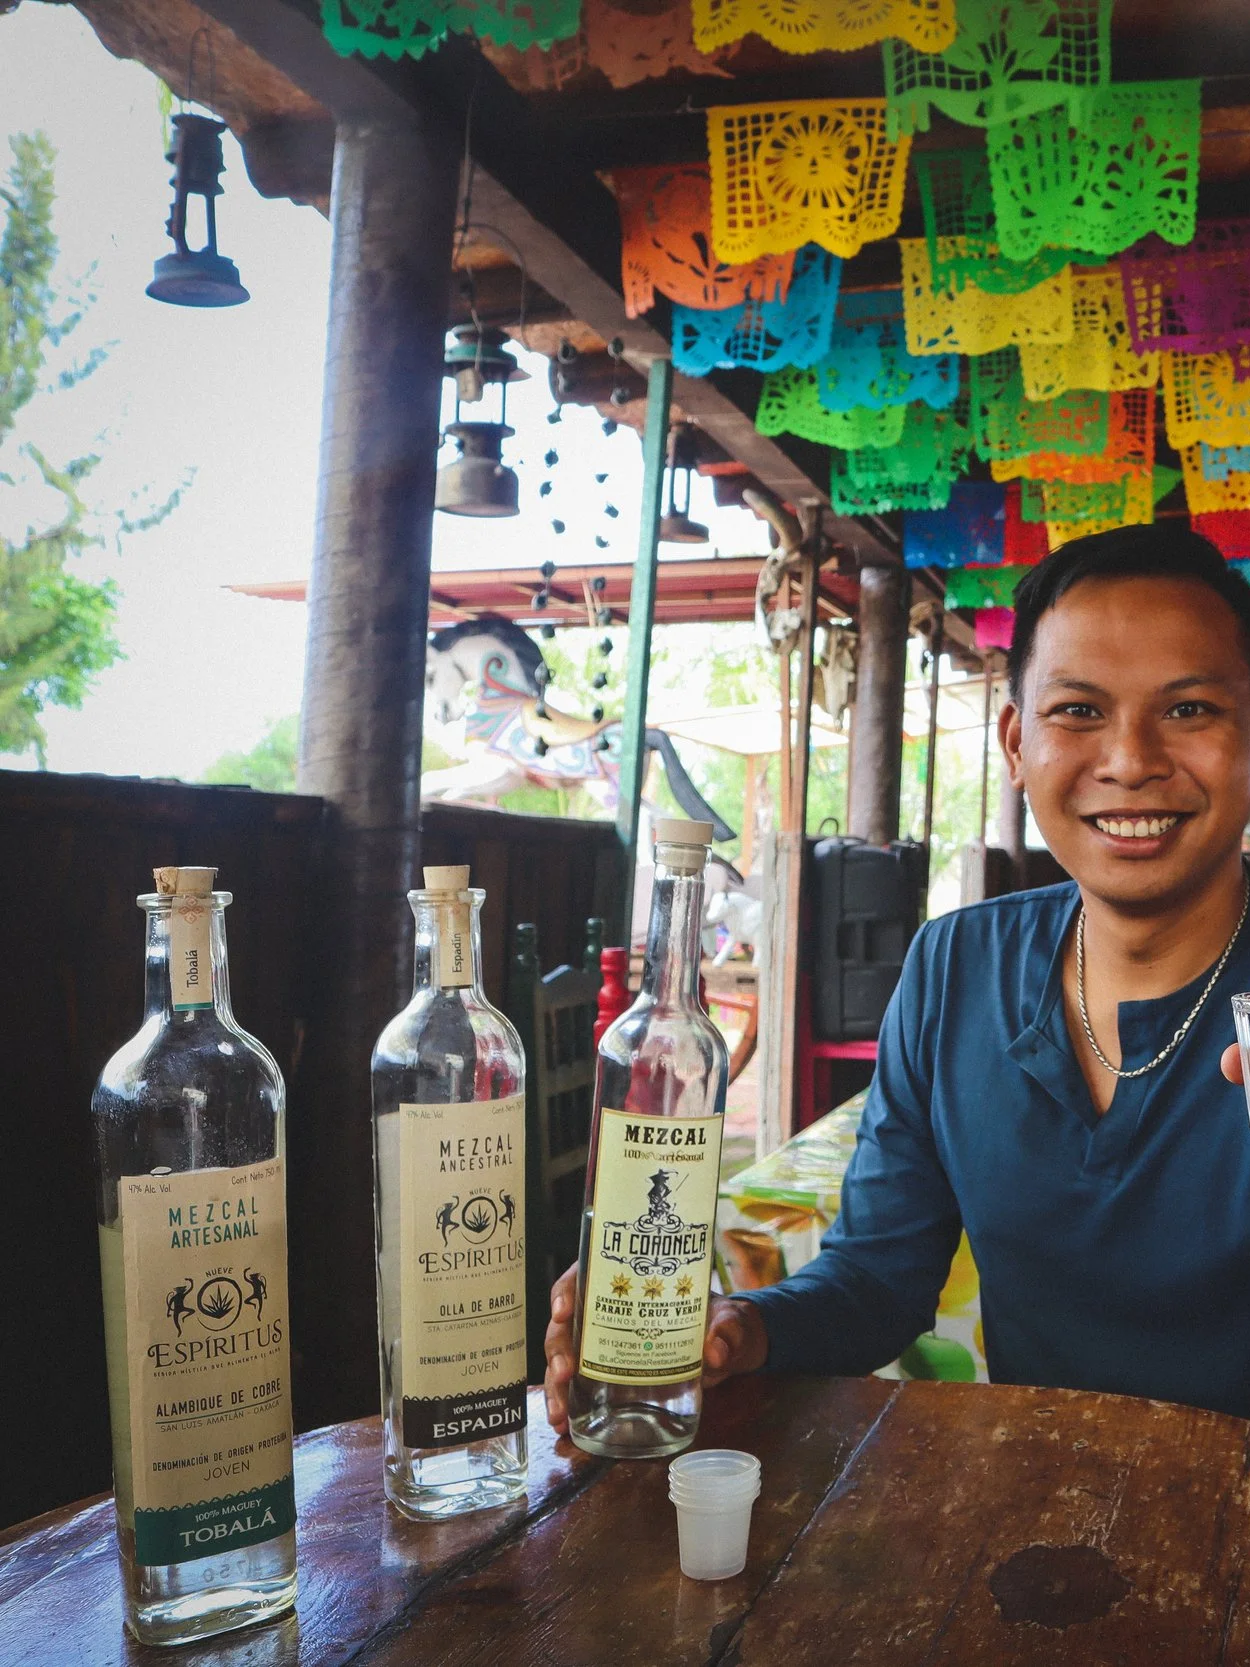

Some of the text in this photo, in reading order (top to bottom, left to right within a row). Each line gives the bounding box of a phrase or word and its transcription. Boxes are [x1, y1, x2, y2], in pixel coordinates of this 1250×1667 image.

[452, 932, 462, 974] Espadín
[186, 949, 198, 988] Tobalá
[440, 1133, 512, 1158] MEZCAL
[624, 1124, 707, 1146] MEZCAL
[440, 1154, 512, 1172] ANCESTRAL
[128, 1184, 142, 1194] 47%
[470, 1188, 492, 1196] NUEVE
[169, 1196, 258, 1227] MEZCAL
[171, 1219, 258, 1248] ARTESANAL
[602, 1230, 706, 1256] LA CORONELA
[418, 1236, 524, 1274] ESPÍRITUS
[205, 1267, 234, 1278] NUEVE
[440, 1294, 515, 1316] OLLA DE BARRO
[595, 1302, 702, 1318] PARAJE CRUZ VERDE
[596, 1296, 634, 1307] CARRETERA
[638, 1298, 692, 1308] INTERNACIONAL
[444, 1322, 478, 1332] CATARINA
[596, 1314, 636, 1326] CAMINOS
[667, 1316, 696, 1326] MEZCAL
[148, 1318, 282, 1368] ESPÍRITUS
[420, 1352, 466, 1365] DENOMINACIÓN
[470, 1351, 478, 1360] DE
[482, 1346, 502, 1358] ORIGEN
[461, 1360, 500, 1377] JOVEN
[156, 1378, 281, 1418] ALAMBIQUE DE COBRE
[453, 1398, 508, 1415] 100% MAGUEY
[160, 1422, 178, 1433] SAN
[181, 1419, 203, 1432] LUIS
[206, 1410, 244, 1426] AMATLÁN
[253, 1400, 280, 1415] OAXACA
[433, 1406, 522, 1438] ESPADÍN
[152, 1452, 209, 1472] DENOMINACIÓN
[214, 1452, 223, 1462] DE
[228, 1444, 254, 1459] ORIGEN
[203, 1460, 250, 1482] JOVEN
[195, 1498, 262, 1523] 100% MAGUEY
[180, 1506, 276, 1548] TOBALÁ
